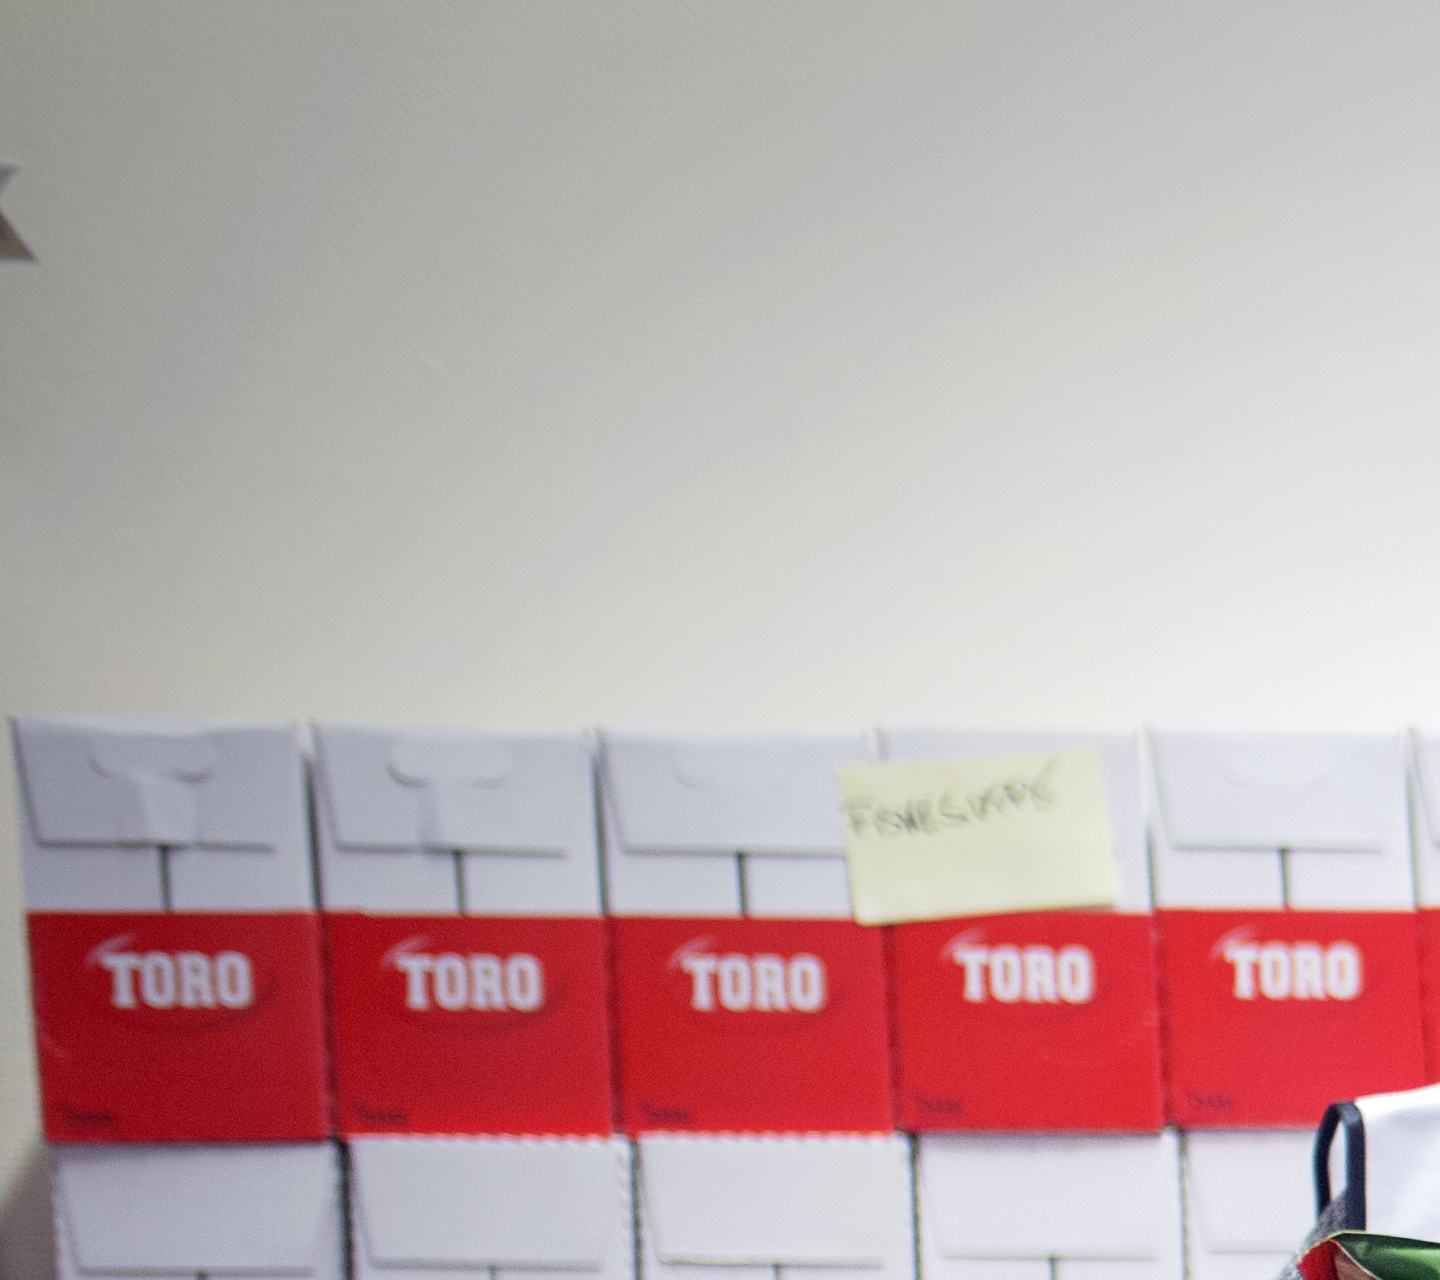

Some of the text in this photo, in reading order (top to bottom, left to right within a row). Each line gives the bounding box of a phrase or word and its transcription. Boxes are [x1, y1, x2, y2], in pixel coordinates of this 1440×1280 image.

[98, 946, 253, 1008] TORO
[394, 950, 543, 1011] TORO
[680, 951, 825, 1011] TORO
[953, 942, 1093, 1003] TORO
[1222, 939, 1361, 999] TORO
